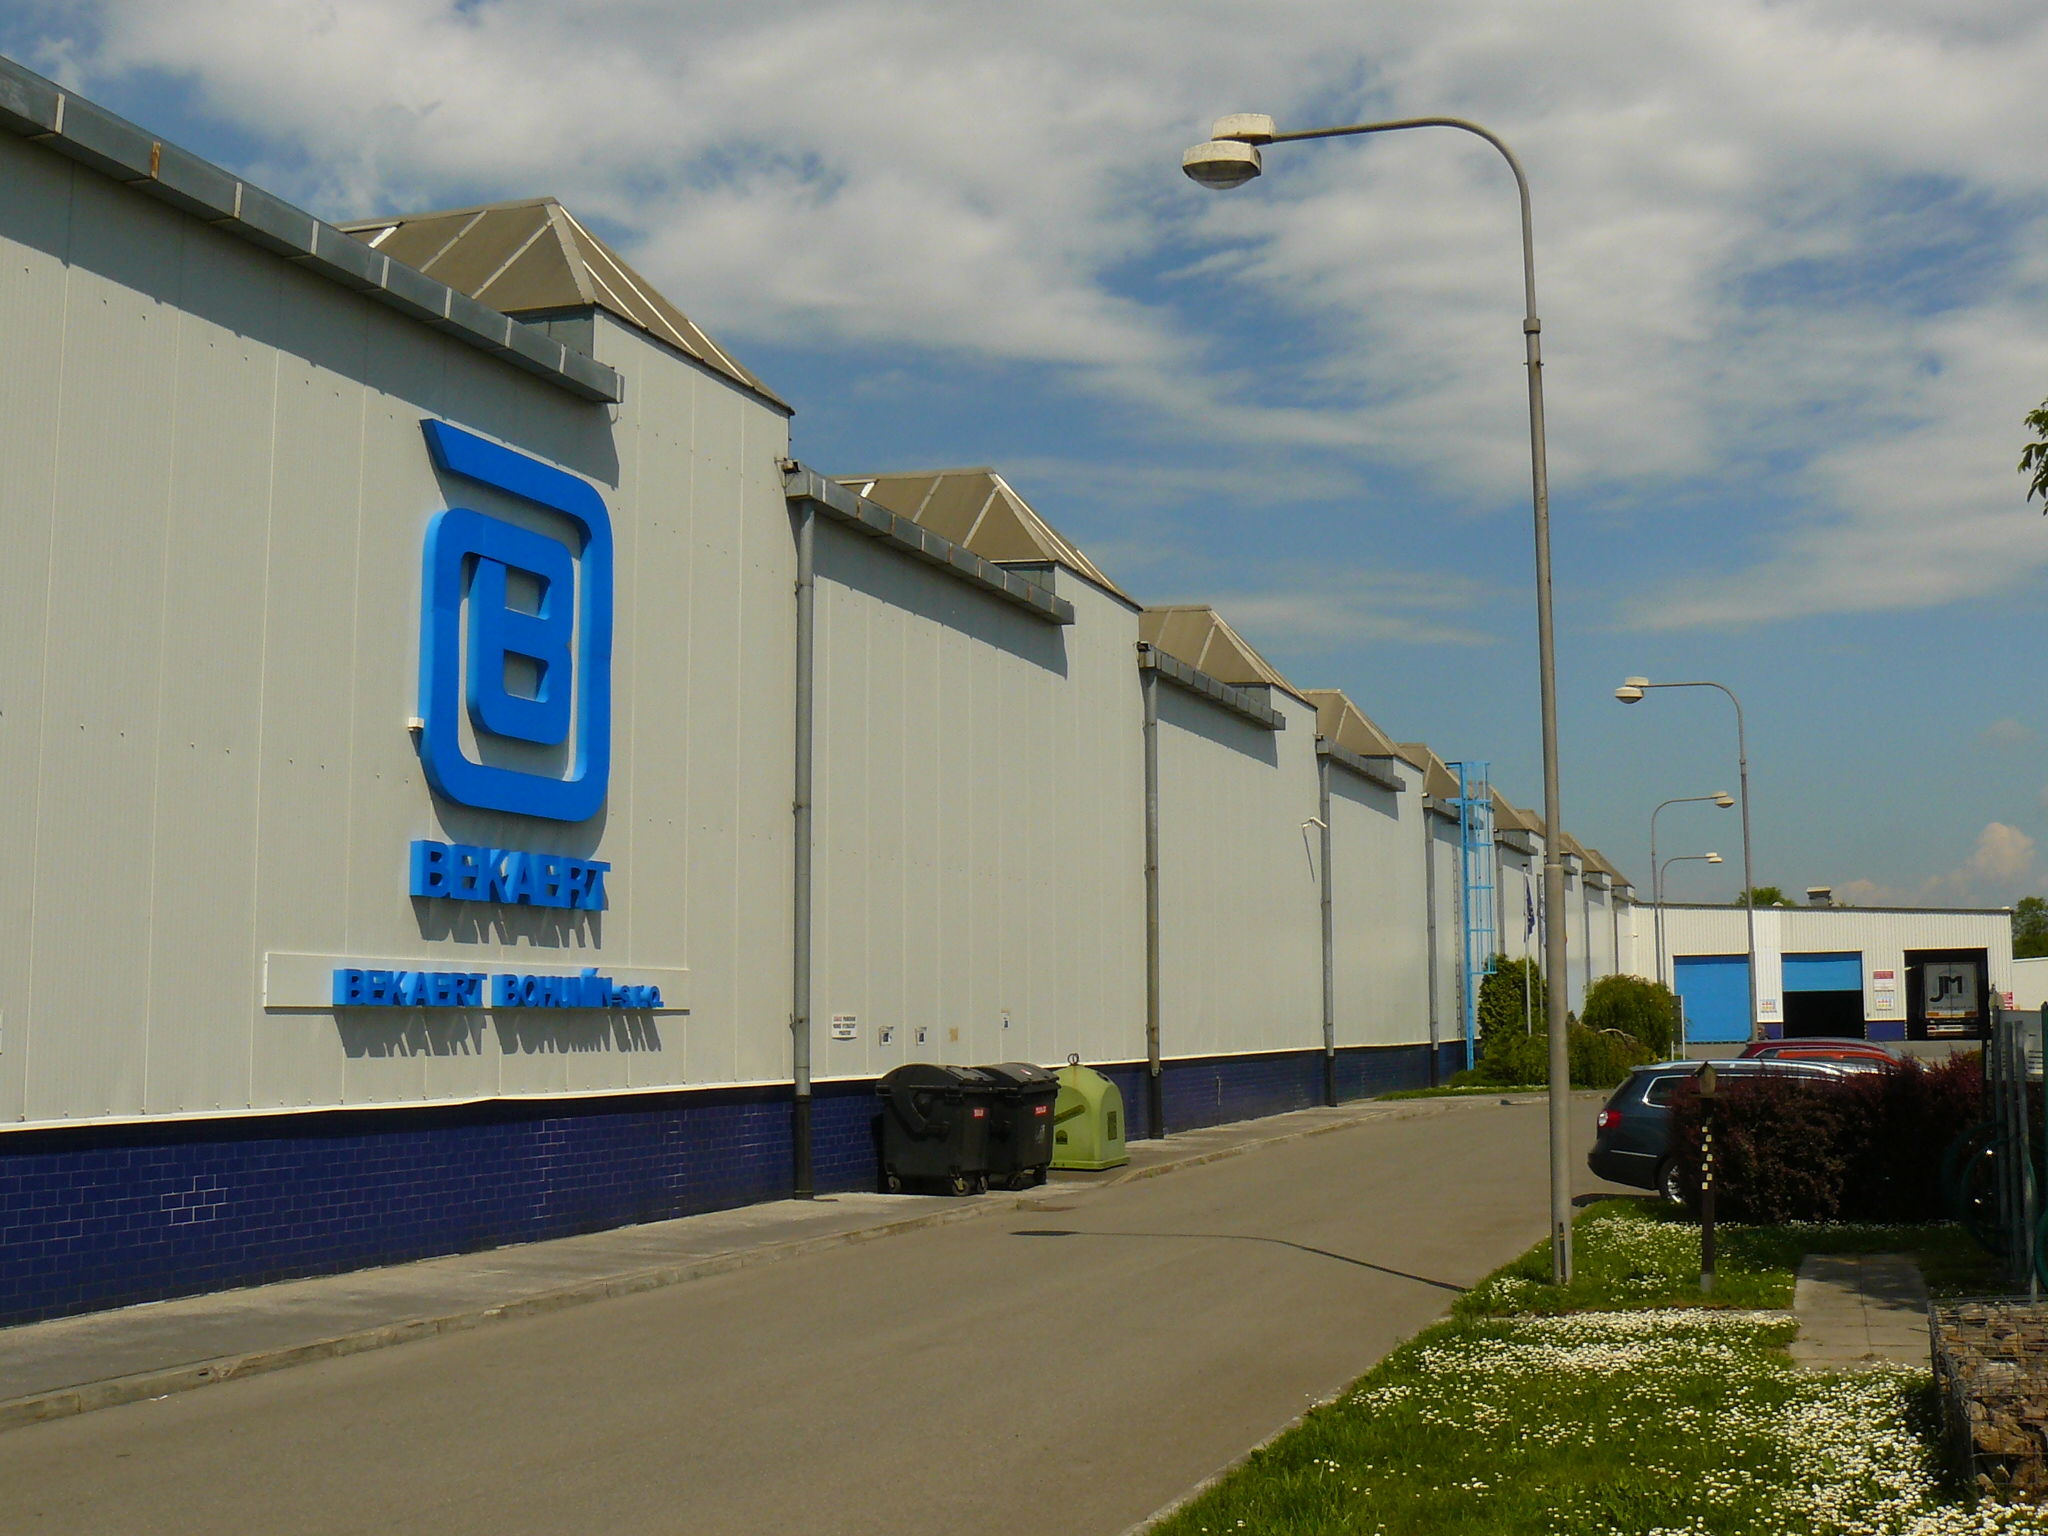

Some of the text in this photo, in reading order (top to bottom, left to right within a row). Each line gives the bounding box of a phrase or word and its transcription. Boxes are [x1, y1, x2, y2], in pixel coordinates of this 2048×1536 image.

[411, 839, 611, 911] BEKAERT
[333, 969, 488, 1007] BEKAERT
[1929, 975, 1963, 1003] JM
